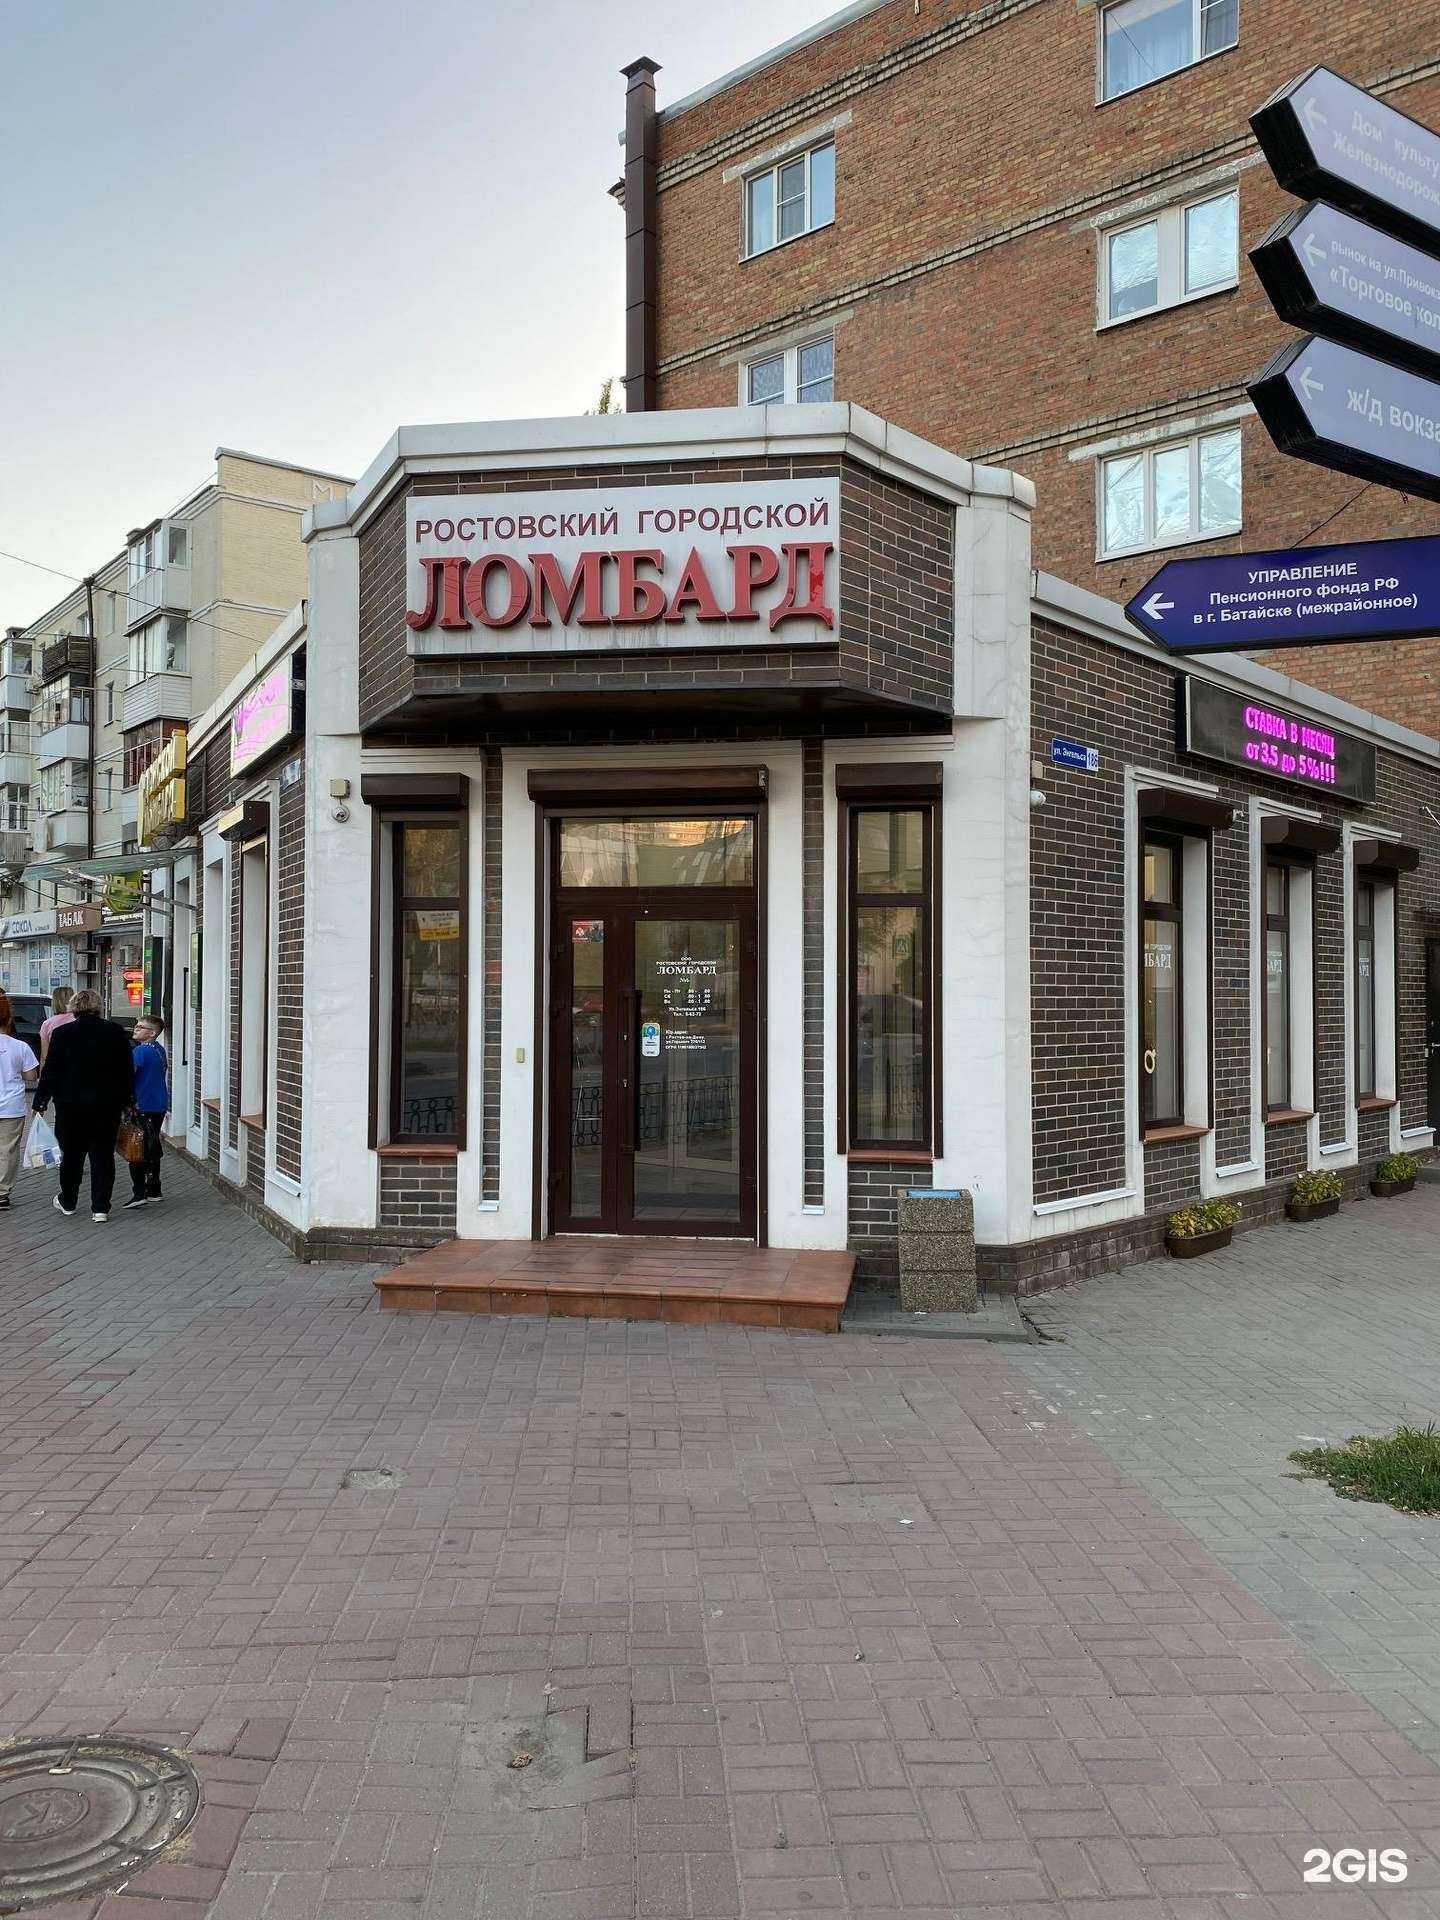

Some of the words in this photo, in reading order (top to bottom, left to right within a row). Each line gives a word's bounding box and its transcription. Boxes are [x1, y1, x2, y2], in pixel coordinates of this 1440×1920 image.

[1352, 110, 1383, 144] Дом
[1331, 240, 1367, 265] рынок
[1369, 257, 1381, 272] на
[1330, 265, 1412, 316] «Торговое
[1347, 389, 1383, 426] ж/д
[415, 506, 618, 542] РОСТОВСКИЙ
[638, 497, 829, 535] ГОРОДСКОЙ
[405, 541, 834, 631] ЛОМБАРД
[1248, 563, 1357, 584] УПРАВЛЕНИЕ
[1210, 587, 1312, 605] Пенсионного
[1317, 582, 1369, 598] фонда
[1374, 577, 1399, 591] РФ
[1193, 614, 1203, 624] в
[1207, 613, 1216, 622] г.
[1220, 606, 1292, 621] Батайске
[1296, 593, 1418, 618] (межрайонное)
[1245, 706, 1287, 740] СТАВКА
[1290, 722, 1298, 744] В
[1302, 727, 1335, 760] МЕСЯЦ
[12, 920, 32, 934] СОКОЛ
[58, 910, 84, 928] ТАБАК
[656, 966, 717, 975] ЛОМБАРД
